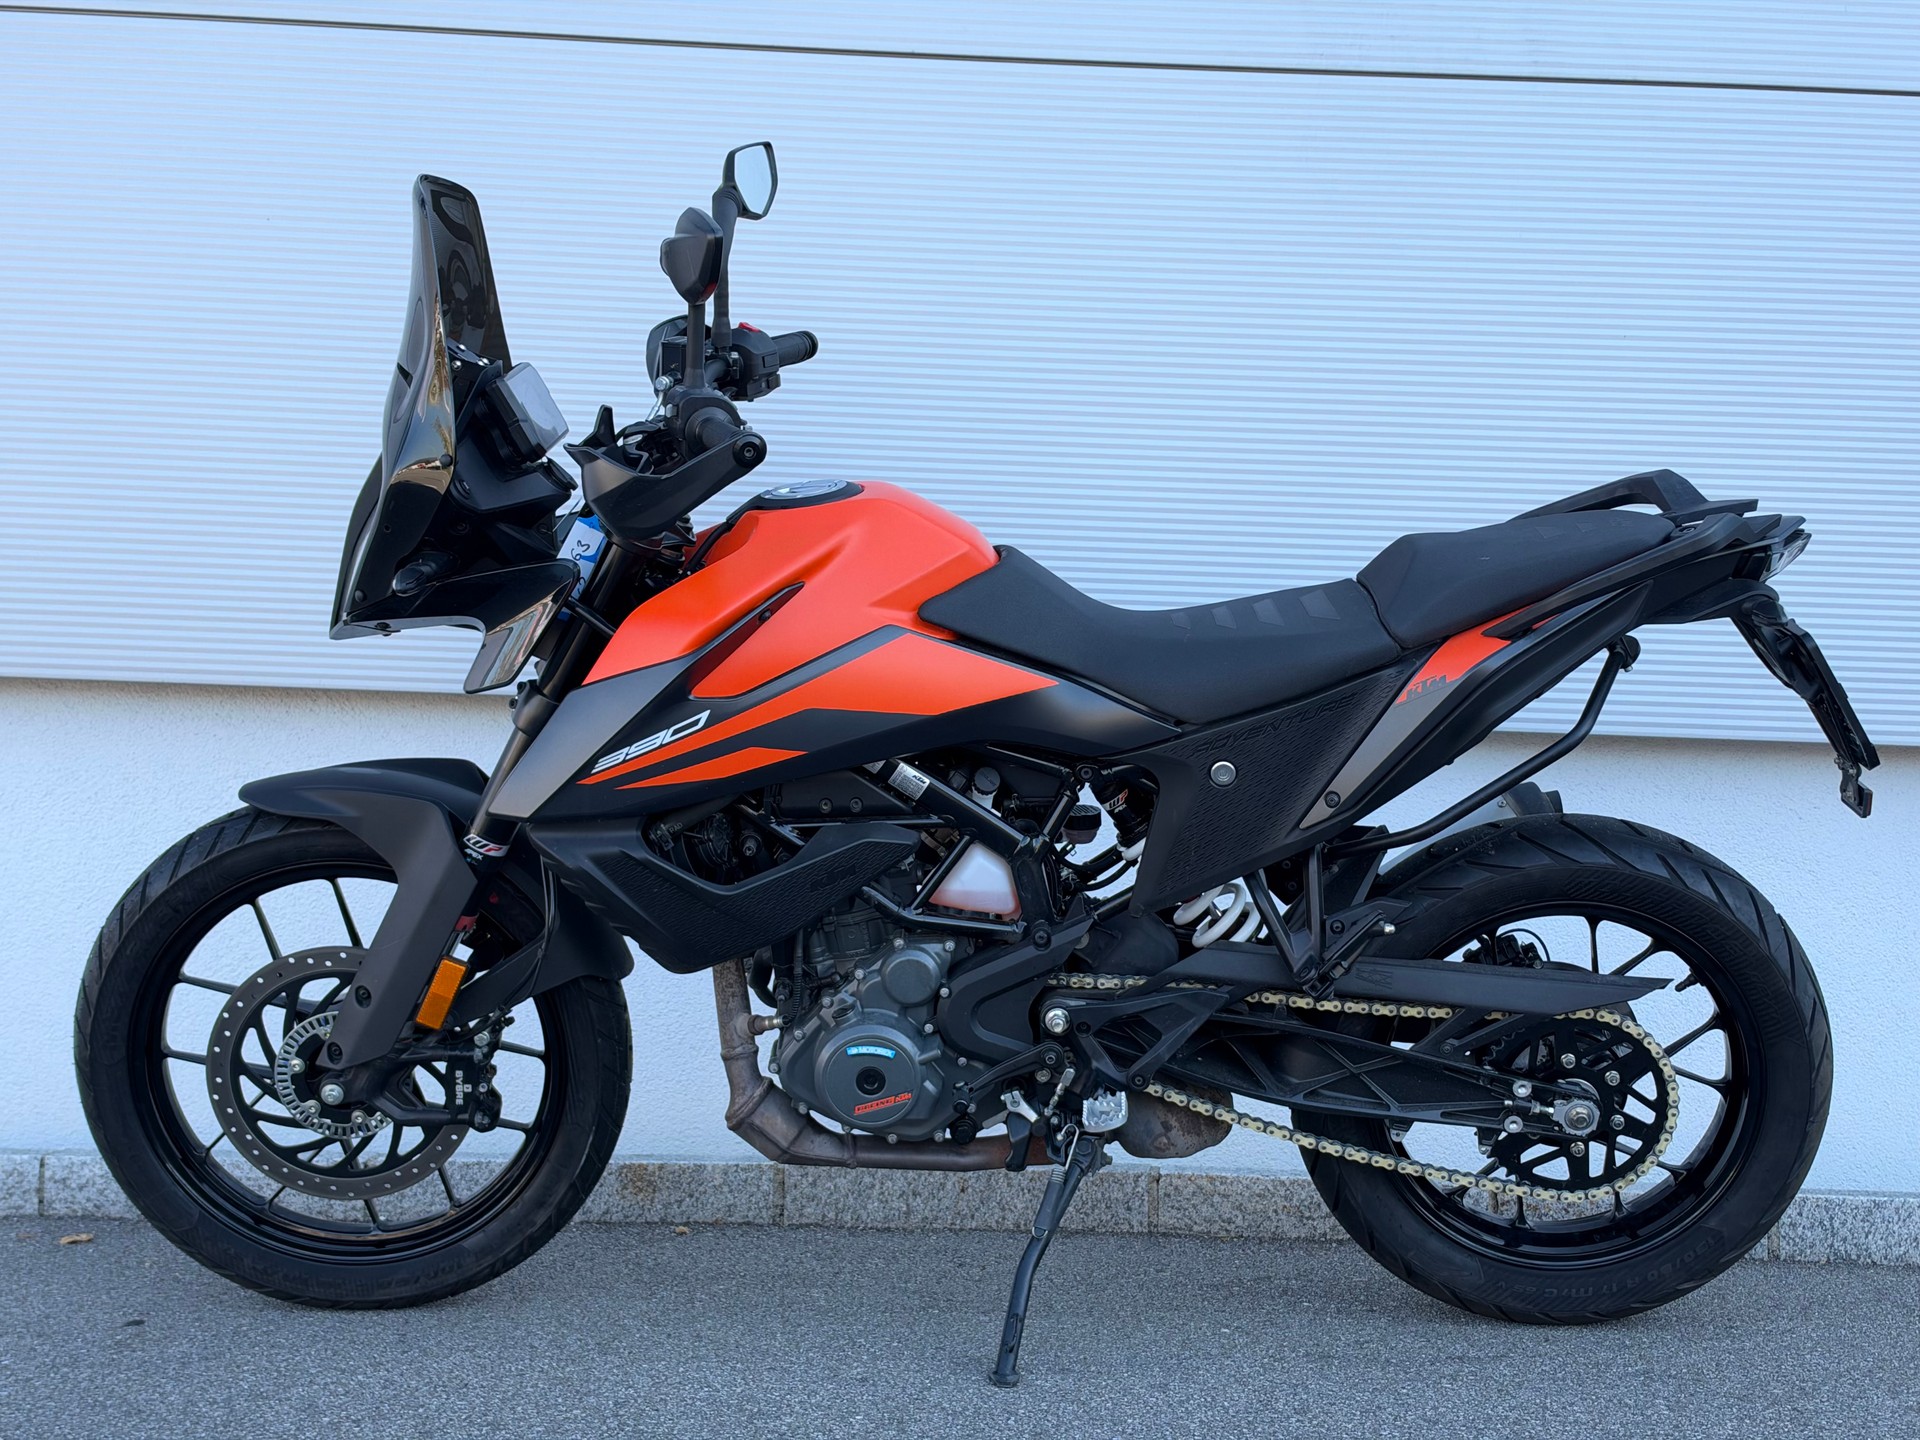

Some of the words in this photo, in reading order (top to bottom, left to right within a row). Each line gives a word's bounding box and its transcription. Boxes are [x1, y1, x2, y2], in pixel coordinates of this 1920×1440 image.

[570, 539, 591, 561] 63
[591, 709, 711, 774] 390
[455, 1069, 464, 1106] BYBRE
